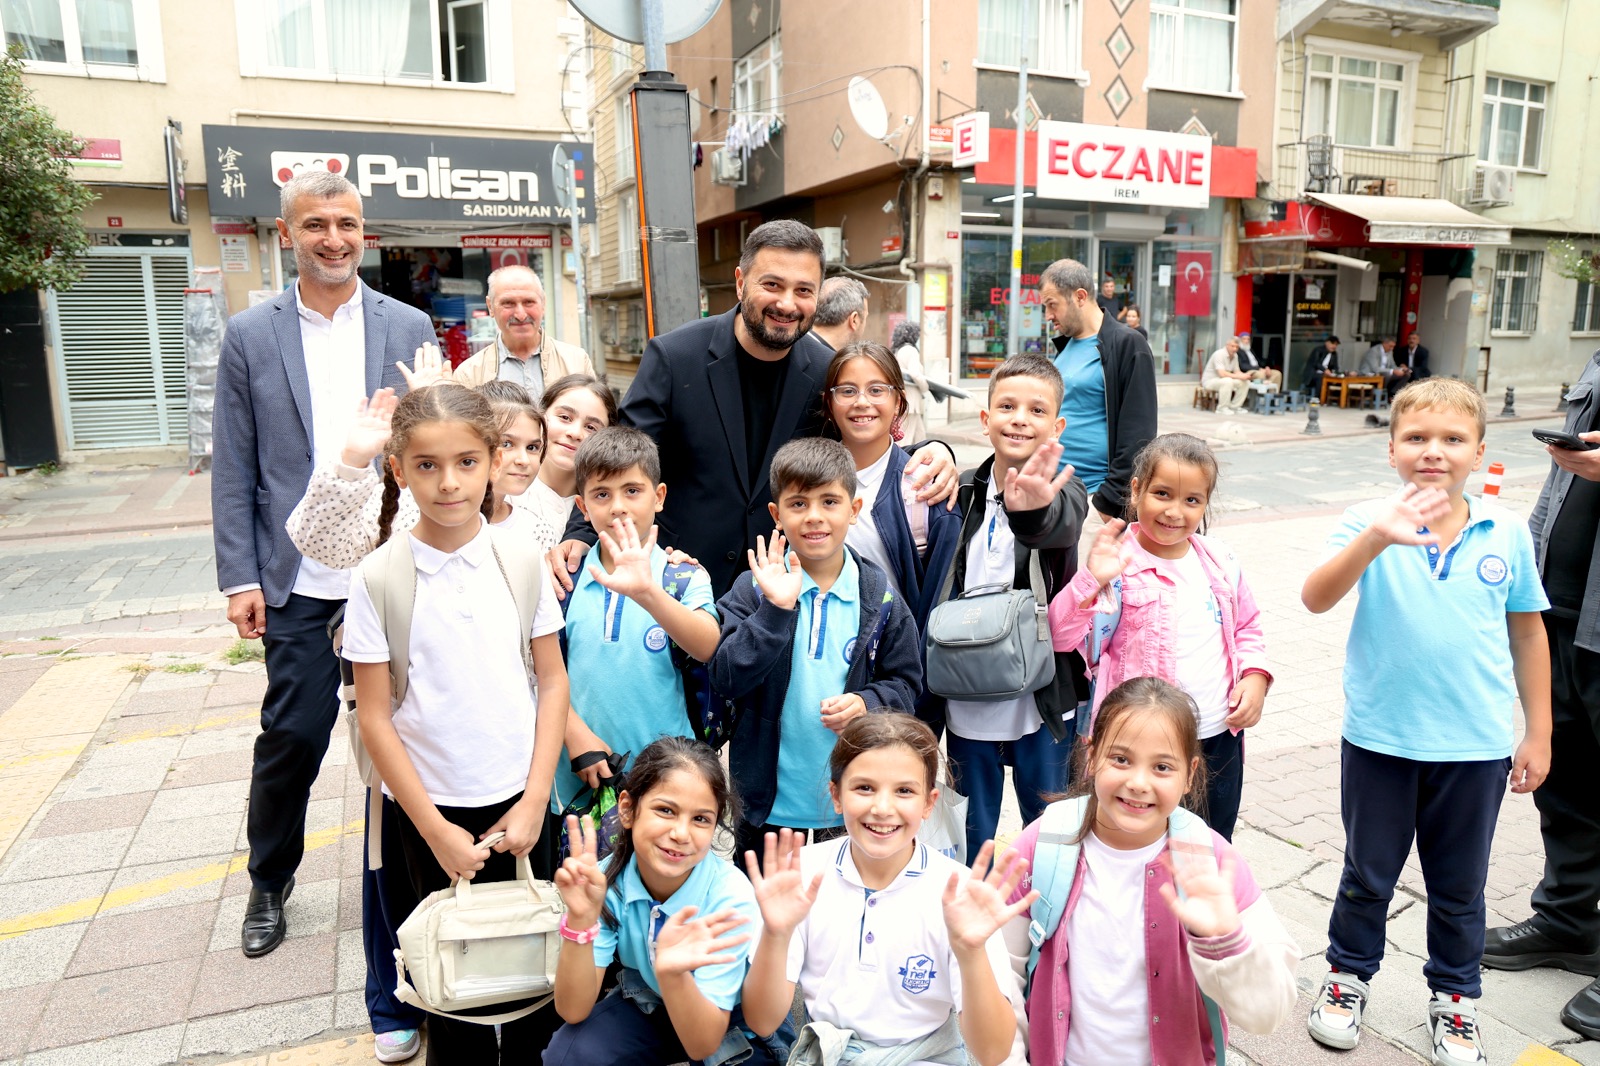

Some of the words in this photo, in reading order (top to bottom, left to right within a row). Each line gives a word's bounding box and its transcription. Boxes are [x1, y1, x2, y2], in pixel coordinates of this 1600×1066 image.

[960, 127, 972, 153] E
[1048, 138, 1204, 185] ECZANE
[356, 153, 539, 202] Polisan
[1114, 185, 1140, 199] İREM
[462, 204, 551, 218] SARIDUMAN
[498, 238, 519, 246] RENK
[1020, 274, 1040, 285] REM
